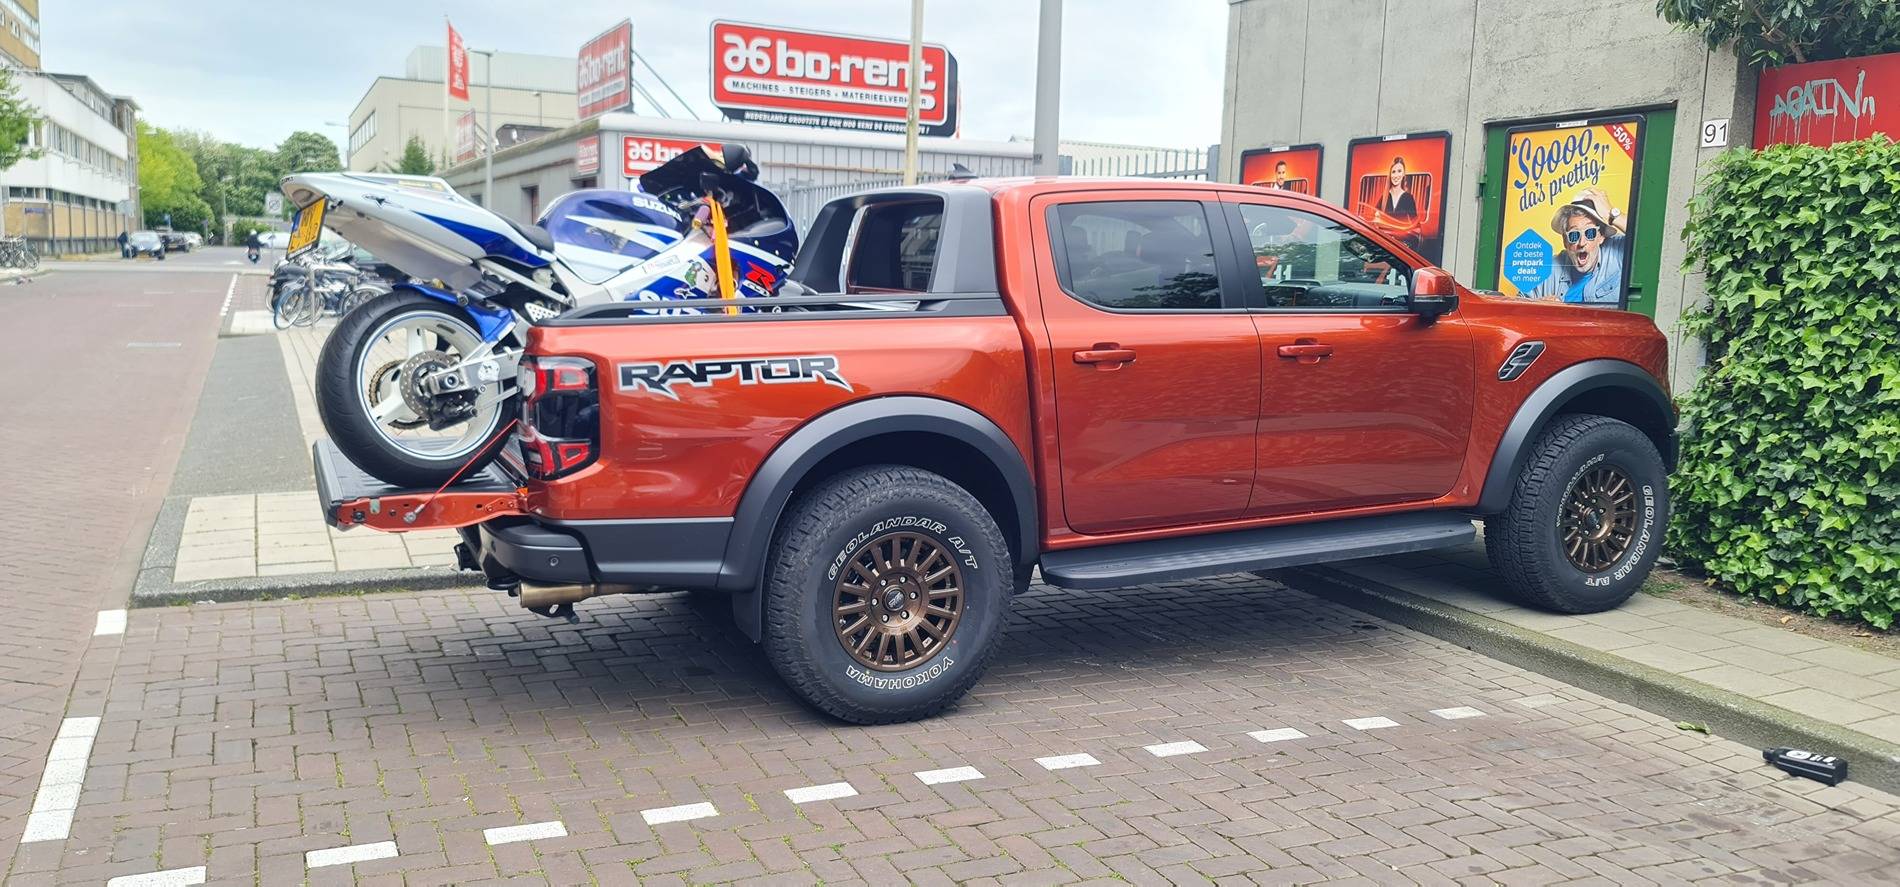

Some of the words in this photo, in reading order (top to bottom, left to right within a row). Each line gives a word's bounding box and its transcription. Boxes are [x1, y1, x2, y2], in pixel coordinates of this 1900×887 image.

[732, 80, 780, 93] MACHINES
[789, 86, 832, 98] STEIGERS
[842, 92, 927, 106] MATERIEELVERHR
[1612, 124, 1633, 151] -50%
[1704, 123, 1727, 143] 91
[1519, 181, 1546, 211] da's
[1512, 250, 1523, 258] de
[1523, 250, 1544, 258] beste
[1515, 241, 1542, 249] Ontdek
[1517, 267, 1537, 275] deals
[617, 354, 854, 401] RAPTOR
[1613, 485, 1655, 581] GEOLANDAR
[828, 516, 947, 580] GEOLANDAR
[948, 536, 978, 569] A/T
[845, 656, 954, 690] YOKOHAMA
